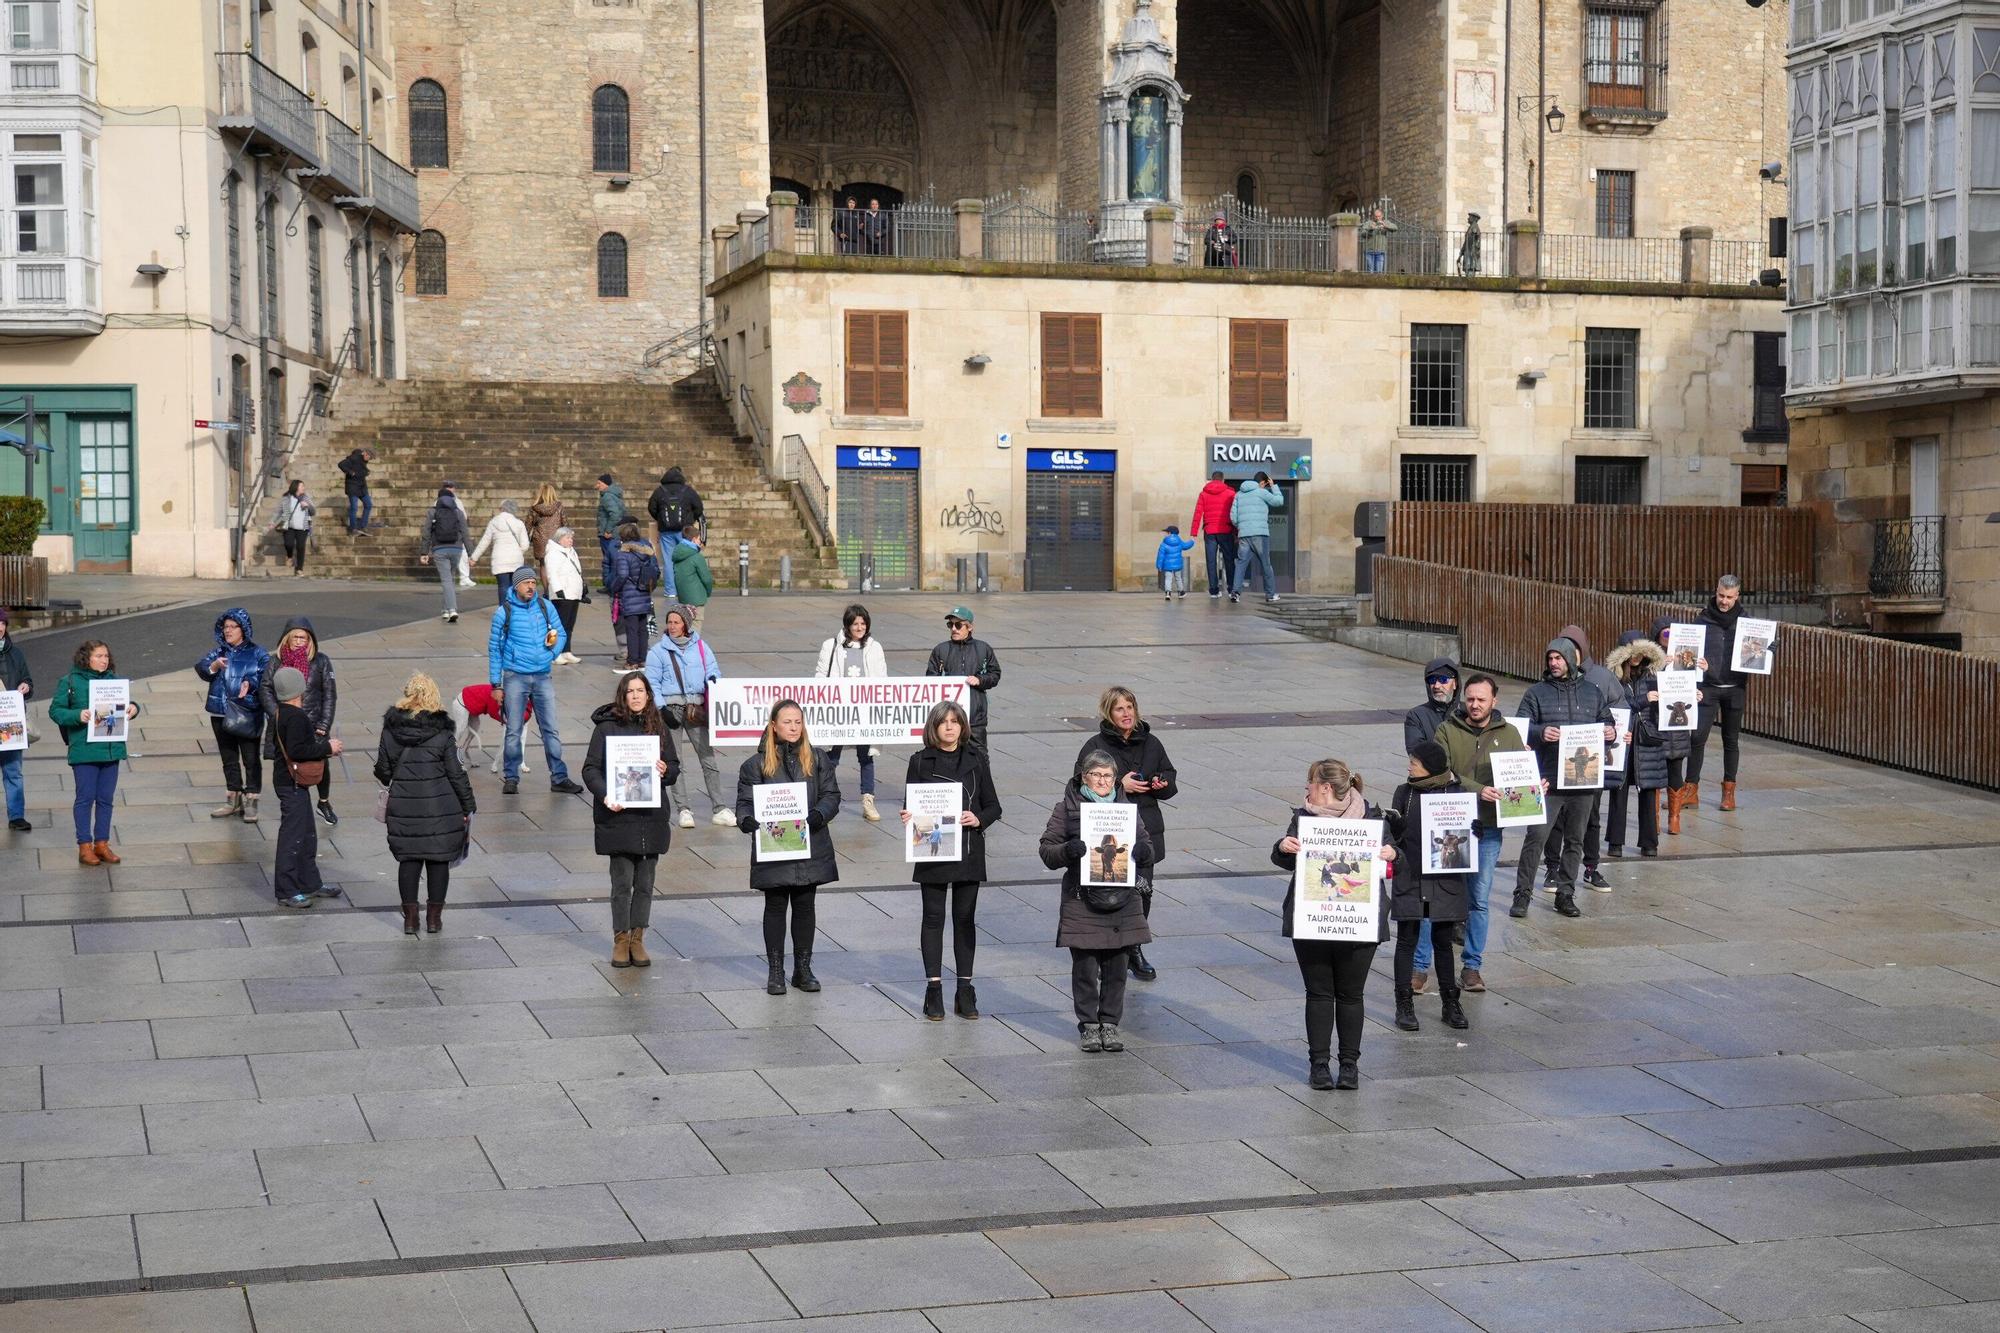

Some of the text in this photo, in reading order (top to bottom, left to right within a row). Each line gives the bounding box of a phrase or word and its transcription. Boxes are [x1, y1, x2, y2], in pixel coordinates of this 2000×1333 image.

[1213, 444, 1276, 461] ROMA
[744, 684, 964, 704] TAUROMAKIA UMEENTZAT EZ
[716, 701, 741, 726] NO
[754, 706, 861, 727] TAMAQUIA
[814, 730, 828, 738] LEGE
[830, 730, 846, 738] HONI
[848, 729, 855, 737] EZ
[860, 729, 869, 737] NO
[876, 728, 892, 737] ESTA
[893, 728, 904, 736] LEY
[1313, 827, 1368, 836] TAUROMAKIA
[1302, 837, 1364, 846] HAURRENTZAT
[1307, 914, 1368, 924] TAUROMAQUIA
[1318, 926, 1357, 935] INFANTIL
